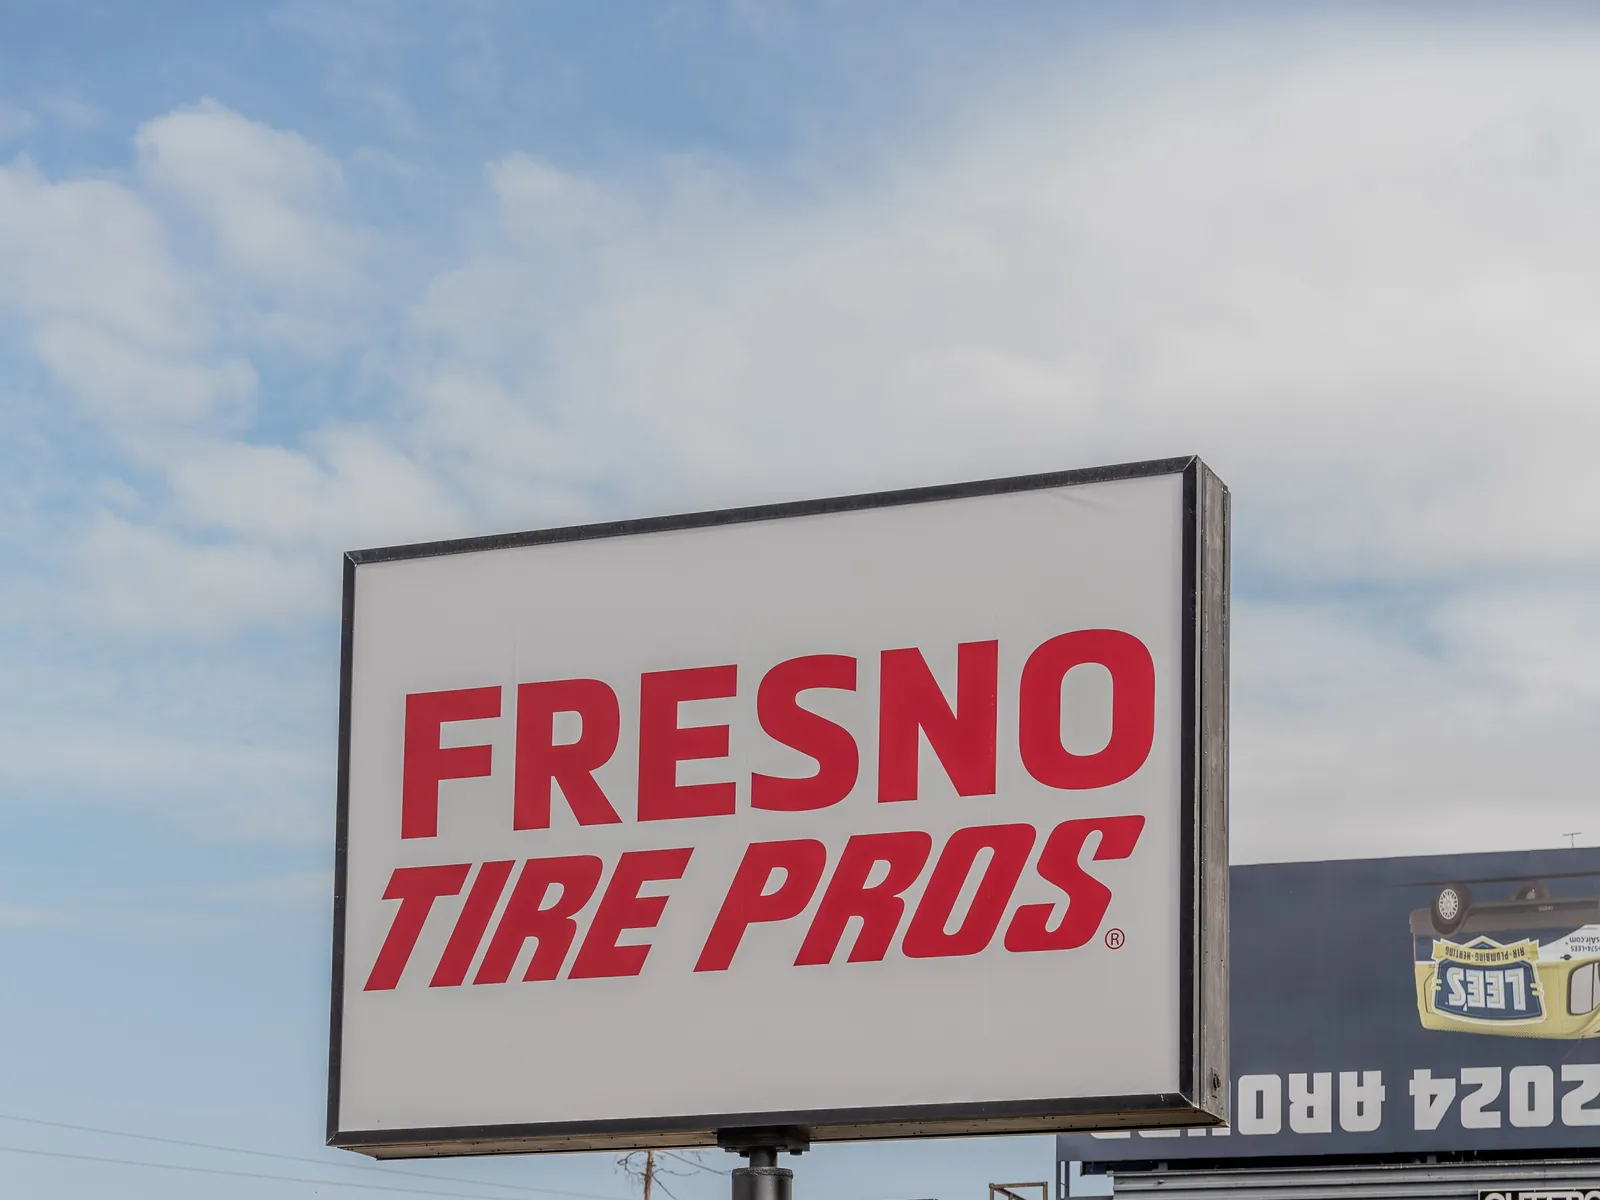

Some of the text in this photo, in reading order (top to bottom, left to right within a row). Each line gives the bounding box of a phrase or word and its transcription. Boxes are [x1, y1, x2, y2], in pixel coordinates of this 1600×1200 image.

[402, 629, 1155, 839] FRESNO
[364, 848, 694, 990] TIRE
[1446, 967, 1527, 1011] LEE'S
[1410, 1064, 1600, 1131] 2024
